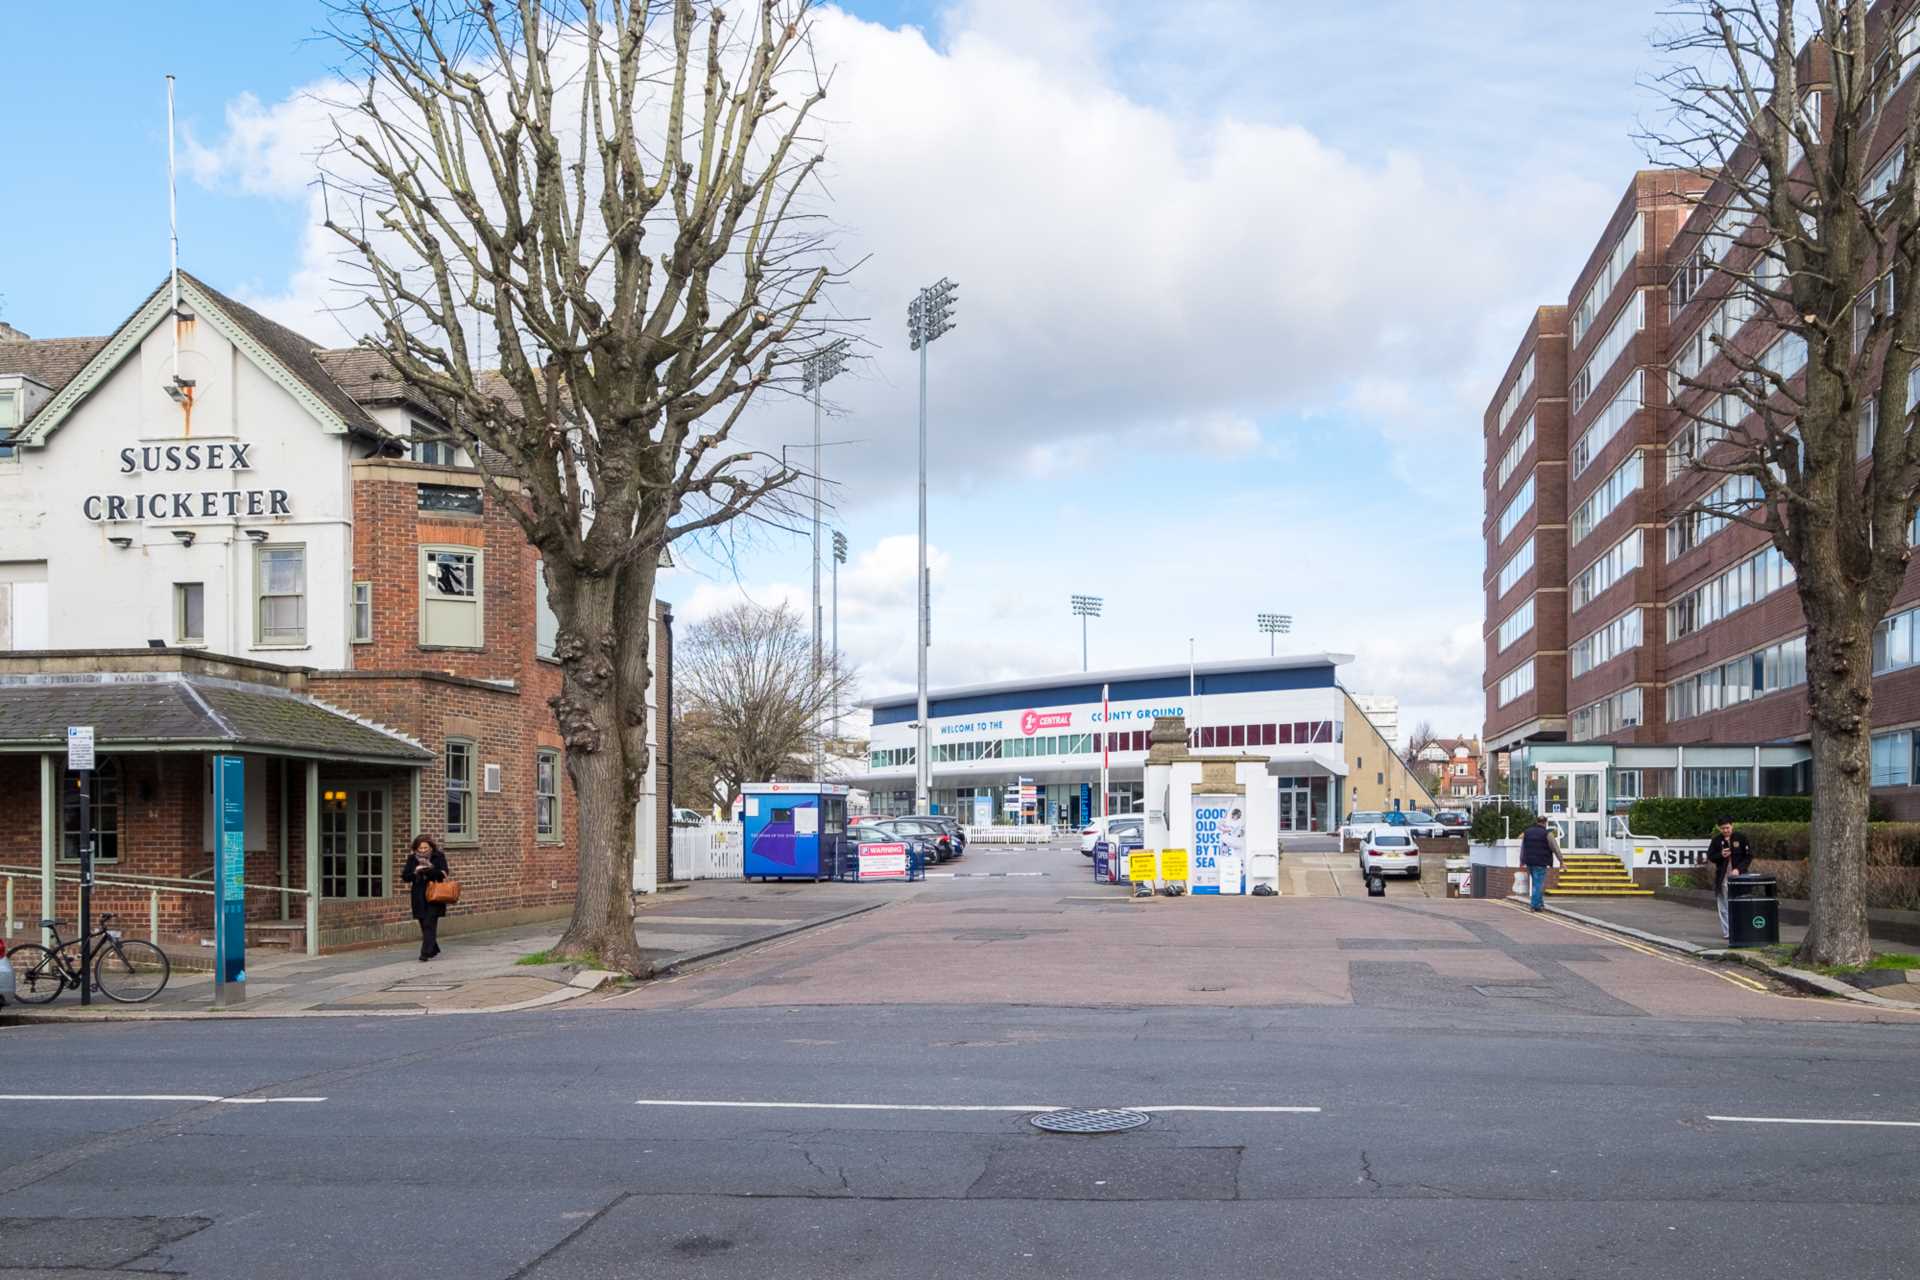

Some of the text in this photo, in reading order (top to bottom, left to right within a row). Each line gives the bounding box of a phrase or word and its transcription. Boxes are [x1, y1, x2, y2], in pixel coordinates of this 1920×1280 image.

[120, 443, 250, 473] SUSSEX
[83, 489, 290, 520] CRICKETER
[1136, 707, 1184, 719] GROUND
[1039, 716, 1070, 725] CENTRAL
[941, 720, 1003, 734] WELCOME TO THE
[1195, 821, 1216, 832] OLD
[1195, 832, 1224, 844] SUSS
[870, 846, 902, 854] WARNING
[1195, 845, 1209, 856] BY
[1195, 857, 1216, 868] SEA
